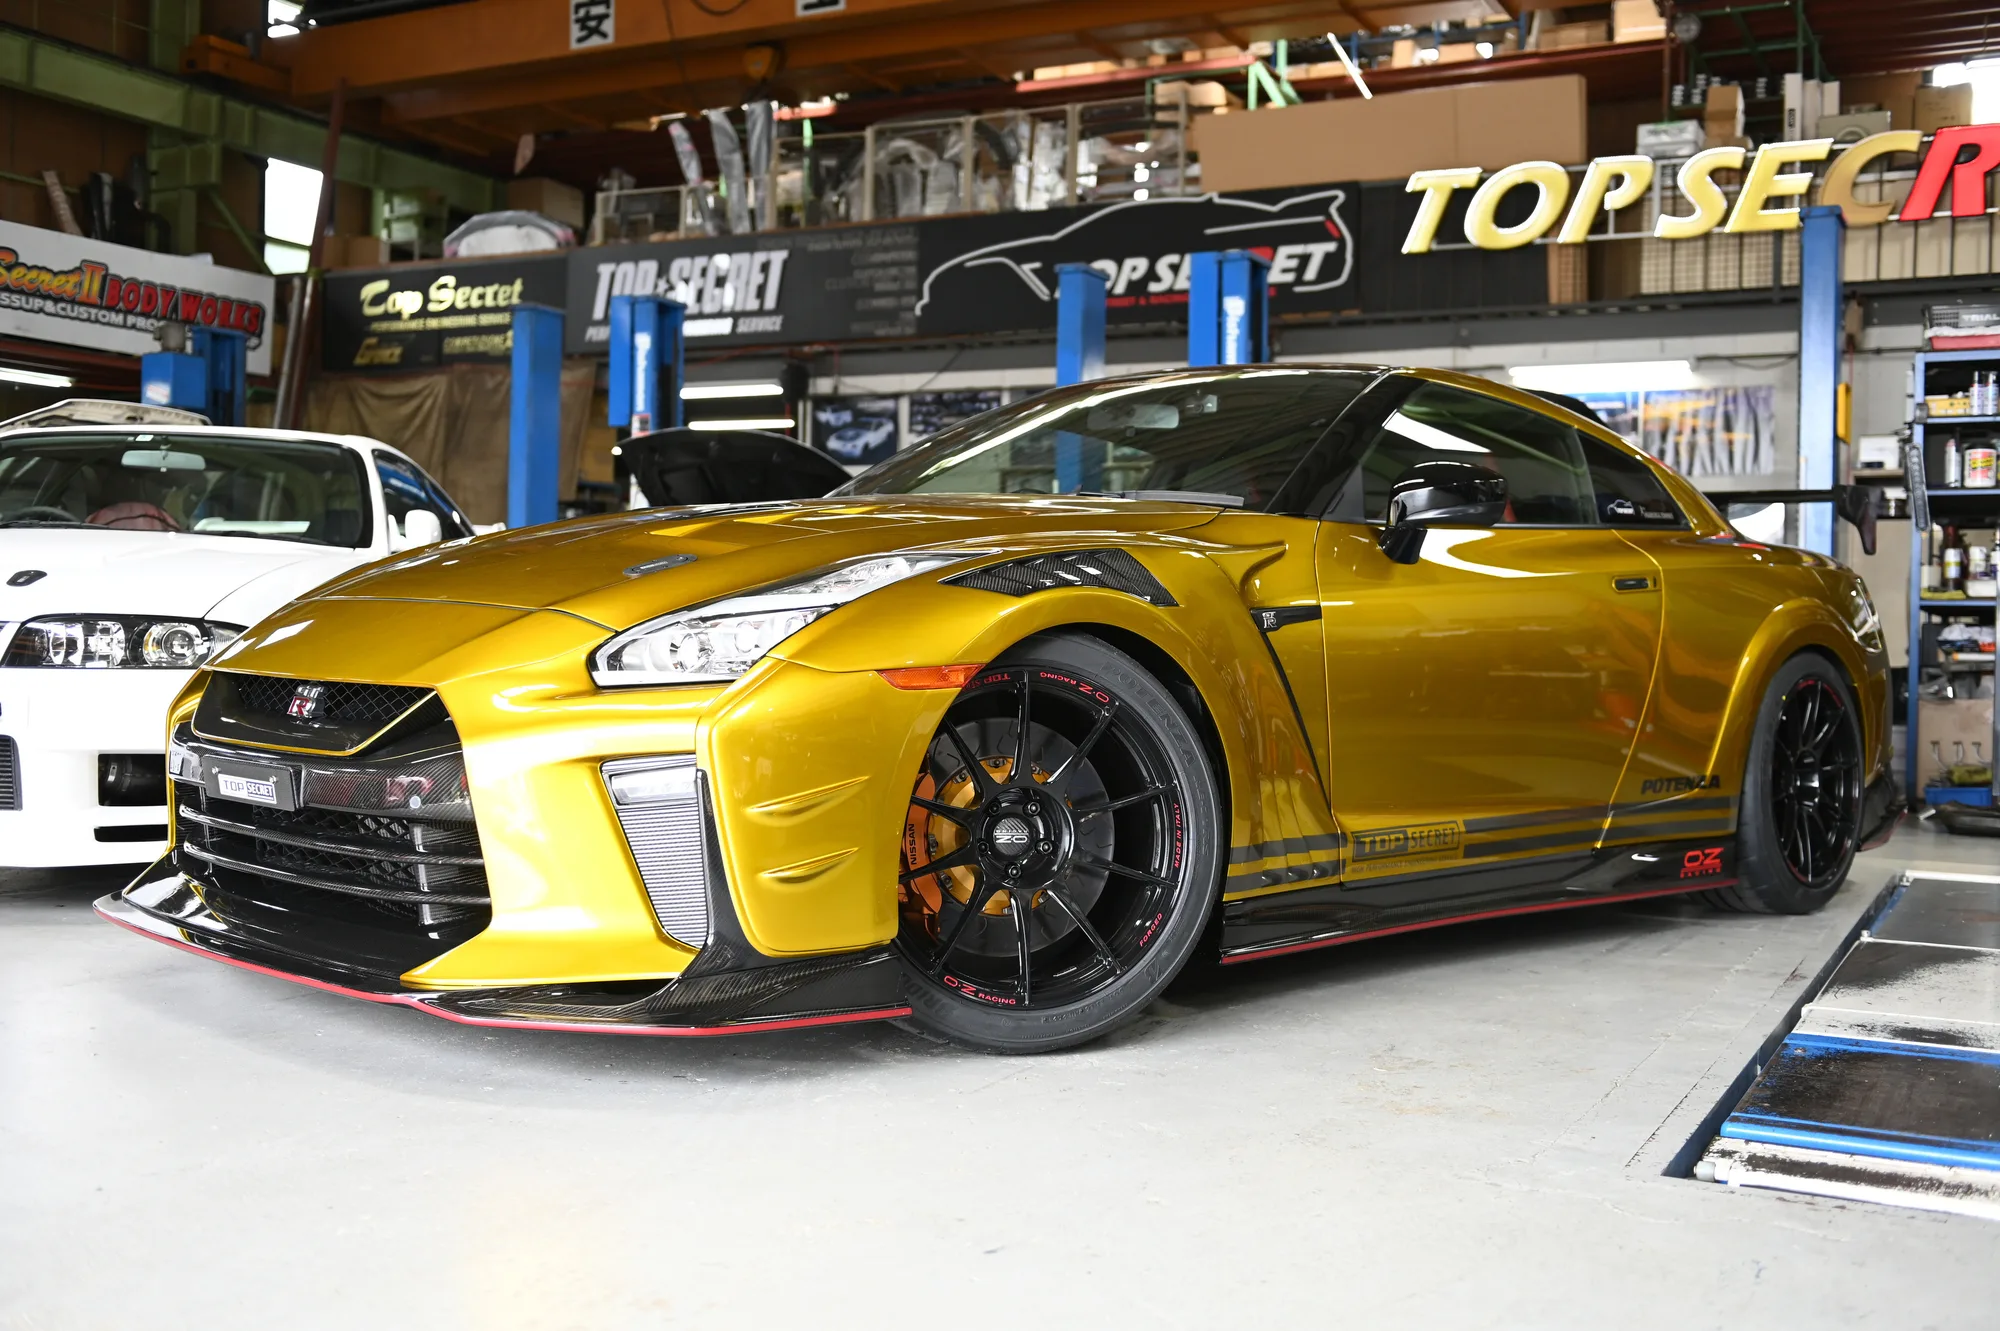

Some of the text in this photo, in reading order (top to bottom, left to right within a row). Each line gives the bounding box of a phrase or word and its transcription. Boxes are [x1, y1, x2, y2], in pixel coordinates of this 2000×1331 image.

[1401, 154, 1654, 254] TOP
[360, 275, 523, 321] Top Secret
[665, 249, 790, 315] SECRET
[103, 278, 176, 319] BODY
[178, 292, 262, 334] WORKS
[1039, 671, 1077, 685] RACING
[223, 780, 274, 797] TOP SECRET
[1641, 775, 1721, 795] POTENZA
[908, 823, 917, 865] NISSAN
[1173, 803, 1182, 868] MADE IN ITALY
[1361, 827, 1456, 853] TOP SECRET
[1139, 912, 1163, 948] FORGED
[978, 993, 1017, 1005] RACING
